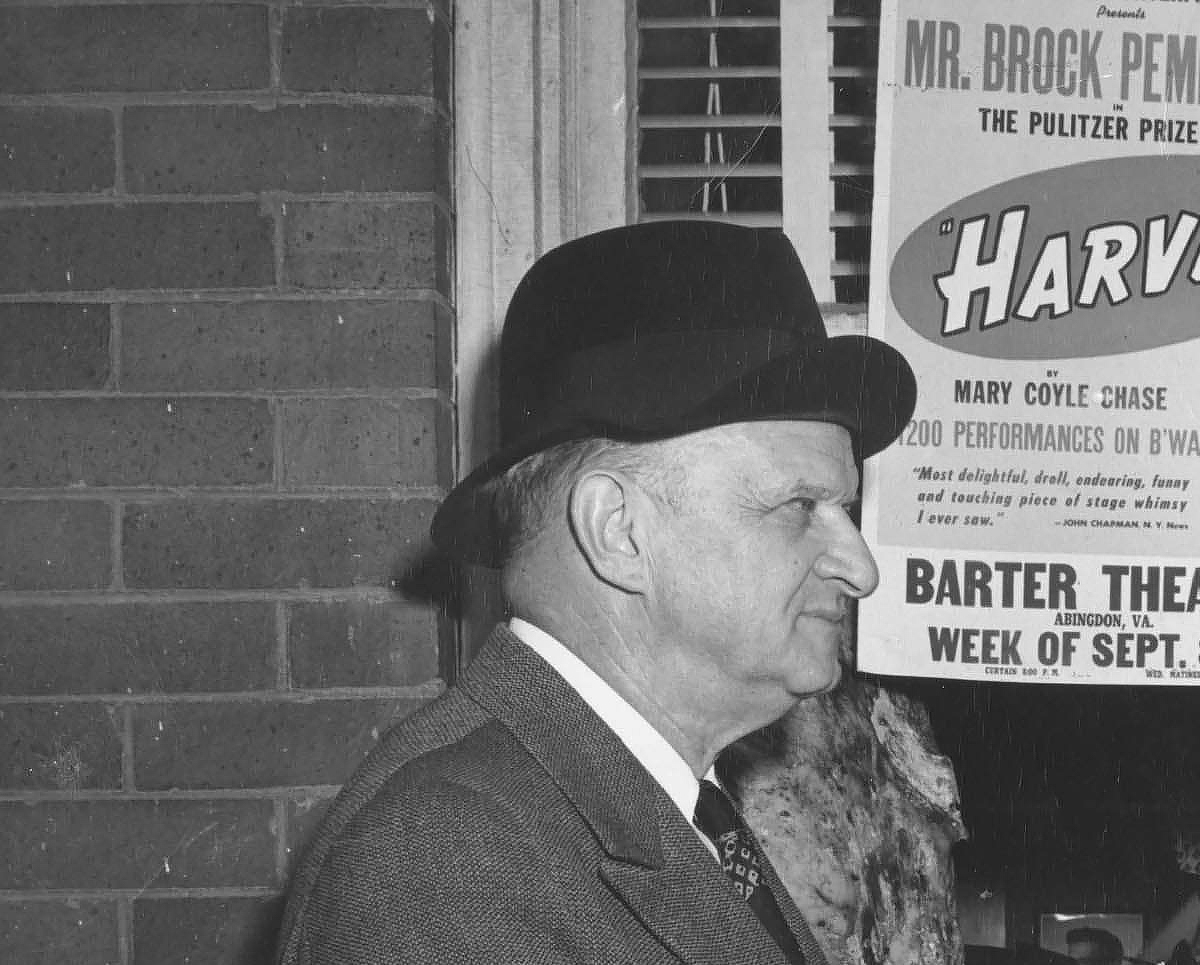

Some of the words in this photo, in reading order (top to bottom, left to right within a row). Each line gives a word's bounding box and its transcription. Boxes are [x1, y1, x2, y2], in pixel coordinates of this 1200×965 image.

[1096, 5, 1146, 19] Presents
[904, 19, 970, 90] MR.
[982, 23, 1103, 99] BROCK
[1112, 104, 1123, 112] IN
[978, 107, 1018, 133] THE
[1030, 111, 1128, 141] PULITZER
[1140, 117, 1198, 144] PRIZE
[1047, 370, 1058, 378] BY
[954, 379, 1012, 405] MARY
[1024, 382, 1089, 408] COYLE
[1100, 385, 1167, 410] CHASE
[954, 420, 1104, 453] PERFORMANCES
[1114, 427, 1140, 454] ON
[958, 467, 1028, 485] delightful,
[1034, 470, 1070, 487] droll,
[1076, 472, 1145, 490] endearing,
[1152, 474, 1190, 491] funny
[917, 489, 945, 503] and
[951, 490, 1012, 507] touching
[1018, 493, 1056, 508] piece
[1065, 492, 1082, 507] of
[1086, 495, 1126, 510] stage
[1134, 495, 1187, 512] whimsy
[917, 509, 924, 524] I
[928, 513, 958, 525] ever
[905, 558, 1077, 610] BARTER
[1054, 612, 1126, 630] ABINGDON,
[1130, 615, 1154, 629] VA.
[928, 626, 1022, 665] WEEK
[1037, 631, 1077, 667] OF
[1092, 632, 1186, 668] SEPT.
